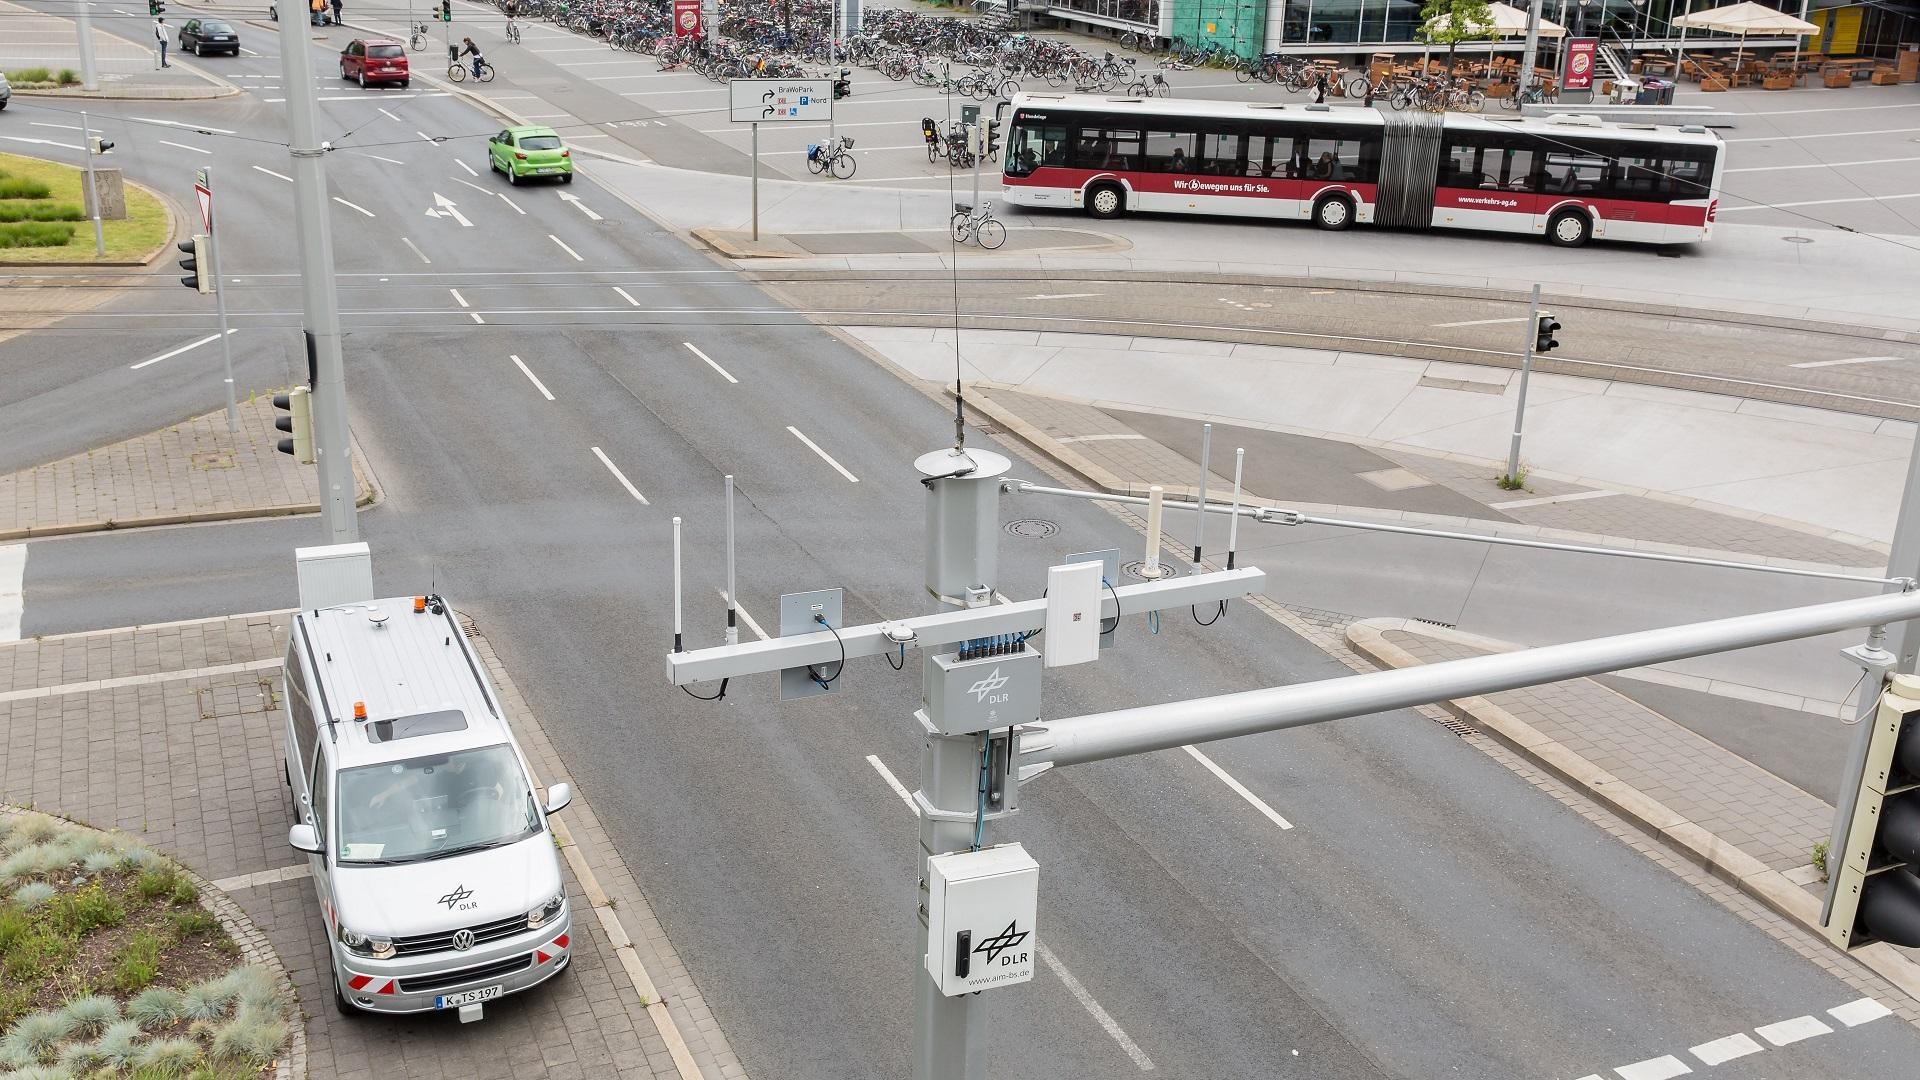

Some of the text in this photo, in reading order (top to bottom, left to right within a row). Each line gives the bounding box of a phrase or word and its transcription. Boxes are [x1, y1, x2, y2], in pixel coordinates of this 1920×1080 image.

[1174, 180, 1188, 189] Wir
[1243, 184, 1255, 192] für
[1256, 185, 1270, 193] Sie.
[1458, 197, 1518, 207] www.verkehrs-ag.de
[989, 693, 1009, 704] DLR
[459, 901, 478, 911] DLR
[1001, 952, 1028, 967] DLR
[968, 970, 1030, 986] www.aim-bs.de
[446, 987, 498, 1006] K TS 197
